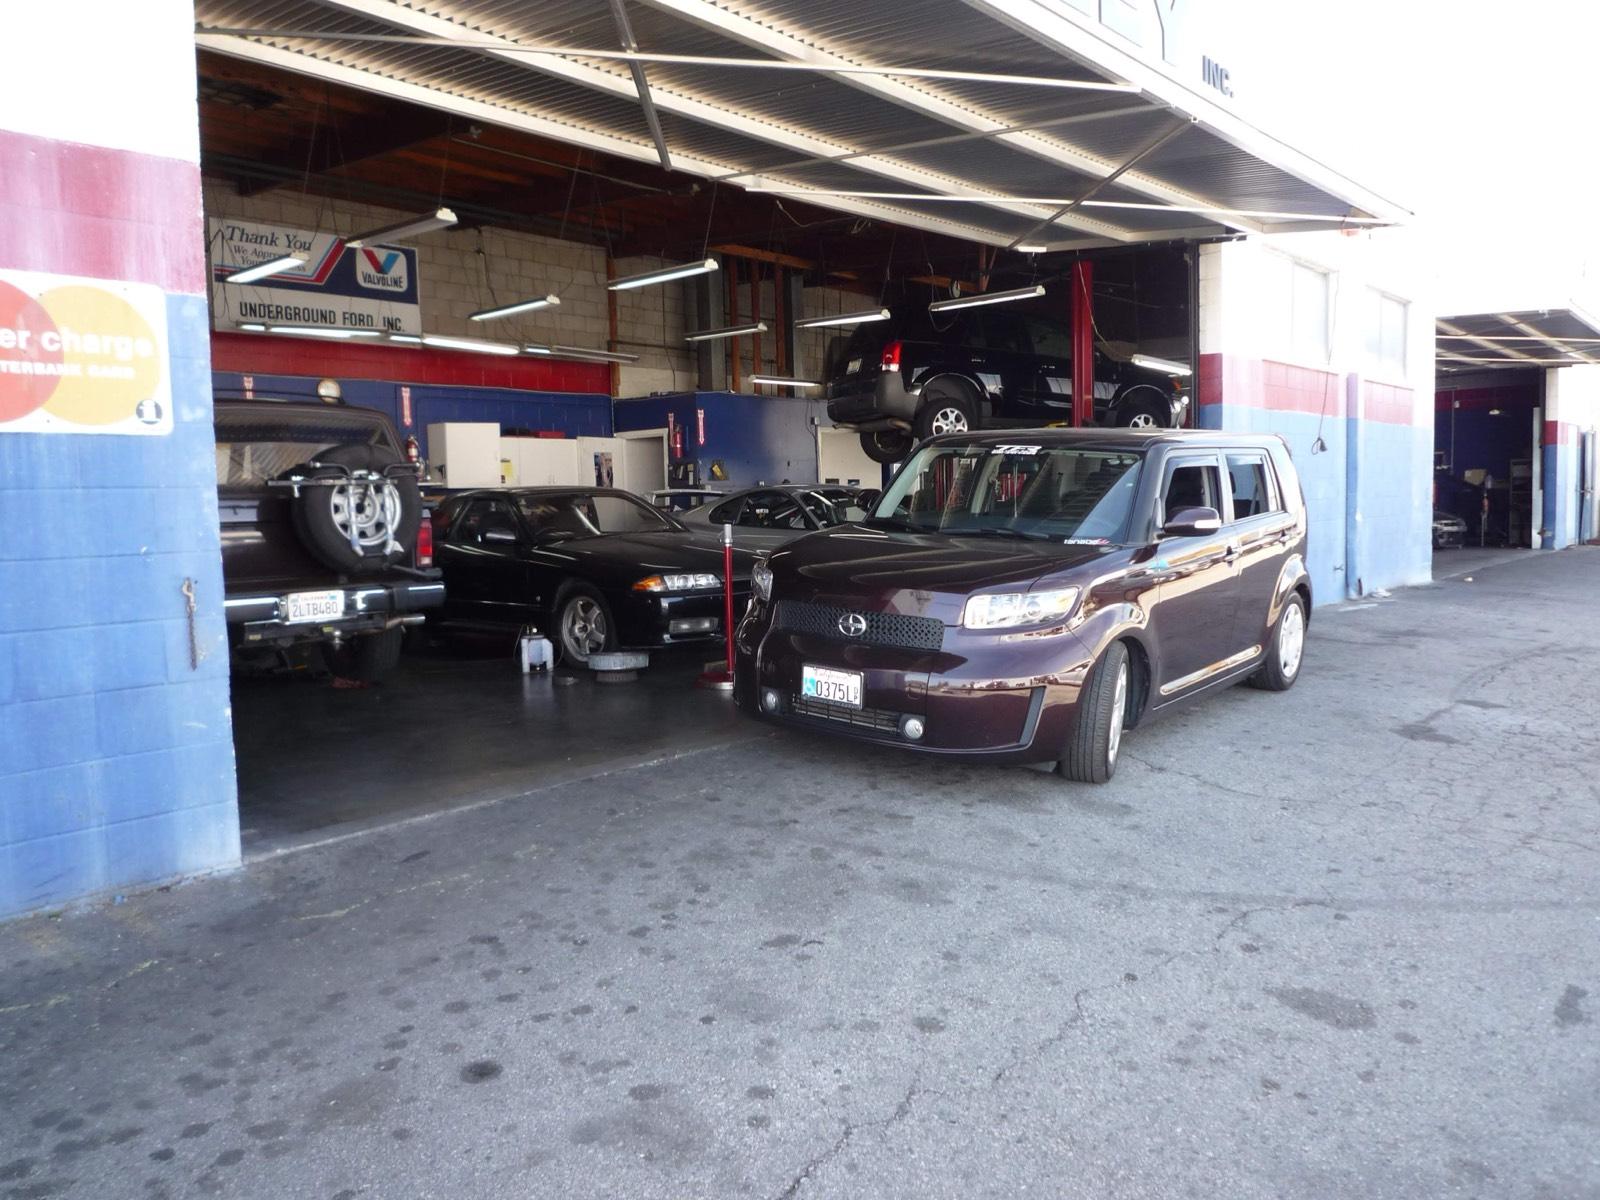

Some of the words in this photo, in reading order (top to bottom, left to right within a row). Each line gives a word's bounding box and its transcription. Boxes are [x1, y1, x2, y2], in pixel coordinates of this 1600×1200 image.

[1202, 55, 1234, 98] INC.
[226, 225, 279, 247] Thank
[285, 234, 312, 251] You
[233, 245, 249, 255] We
[362, 271, 404, 289] VALVOLINE
[239, 301, 336, 325] UNDERGROUND
[40, 325, 155, 361] charge
[815, 680, 854, 703] 0375L
